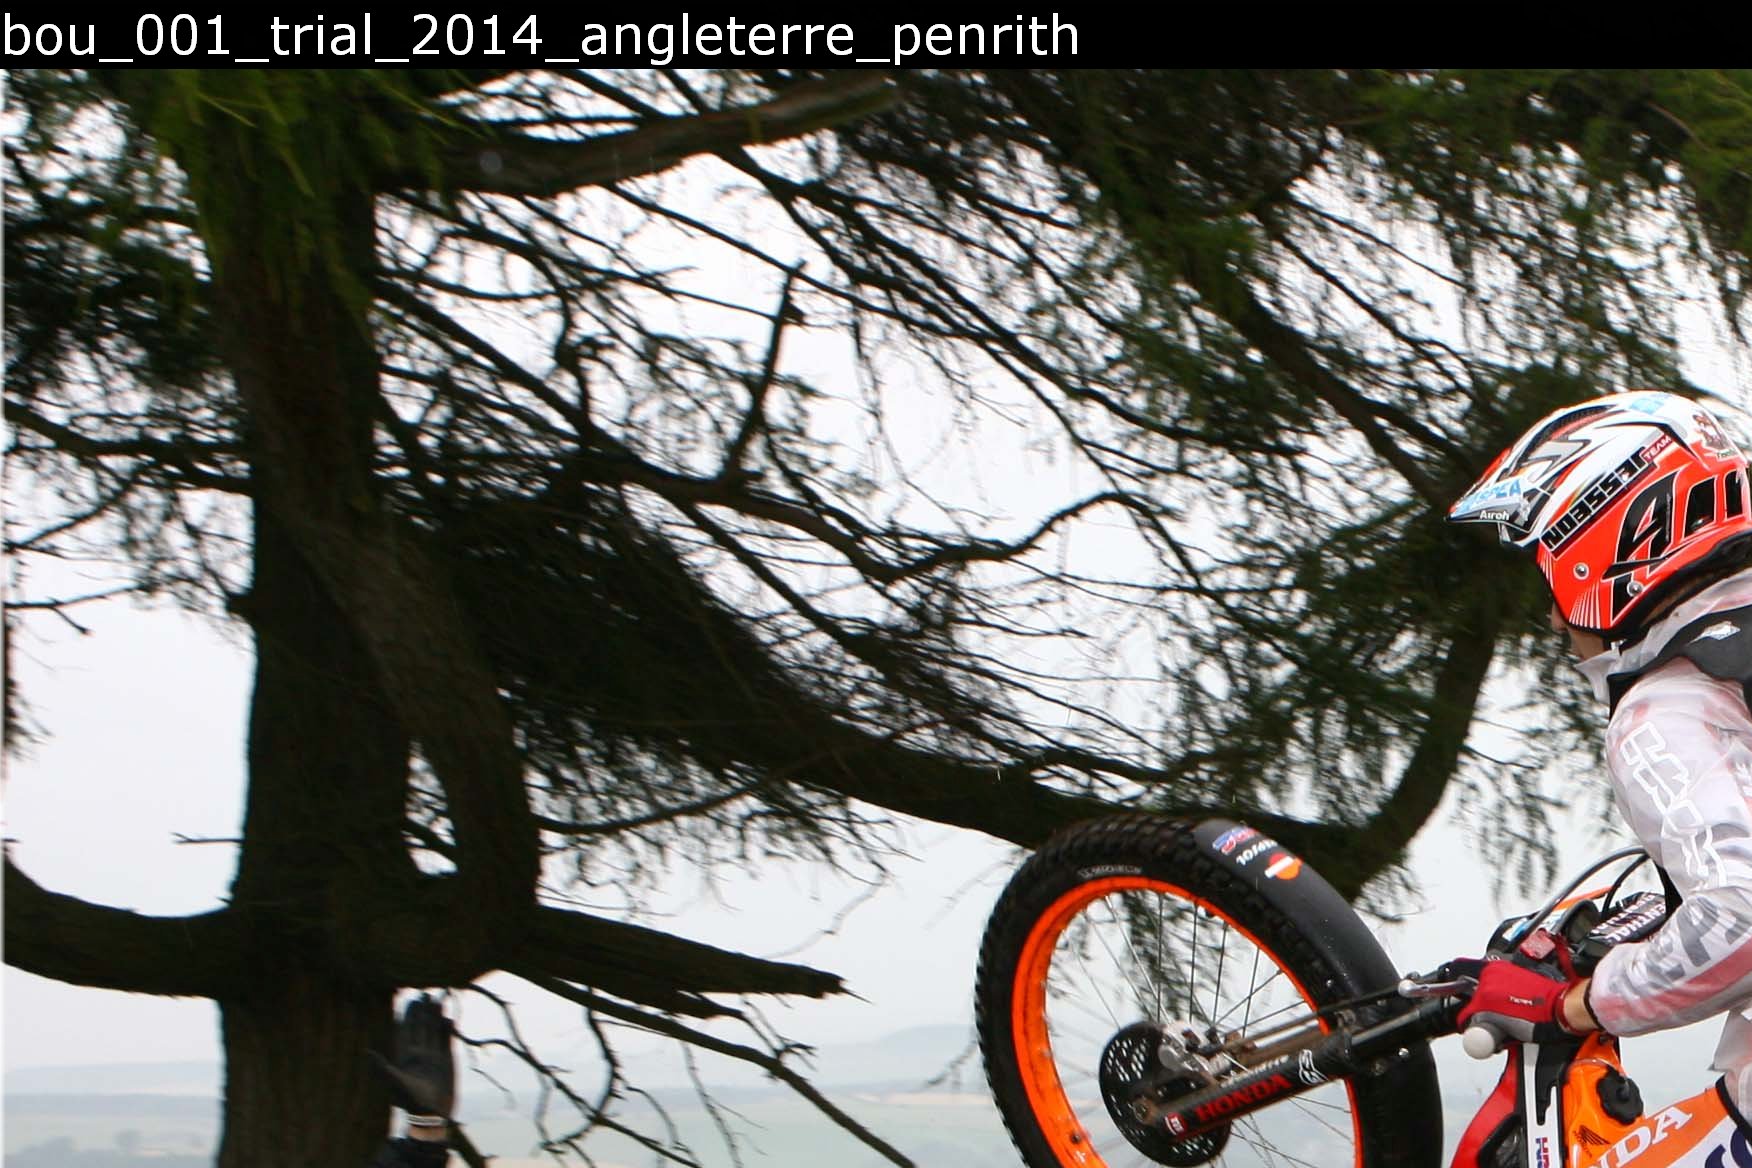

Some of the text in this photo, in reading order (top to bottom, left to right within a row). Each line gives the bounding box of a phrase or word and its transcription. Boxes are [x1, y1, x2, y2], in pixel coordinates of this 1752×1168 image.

[1645, 434, 1673, 461] TEAM
[1480, 510, 1510, 521] Airoh
[1604, 902, 1667, 943] ENTHAL
[1194, 1072, 1293, 1122] HONDA
